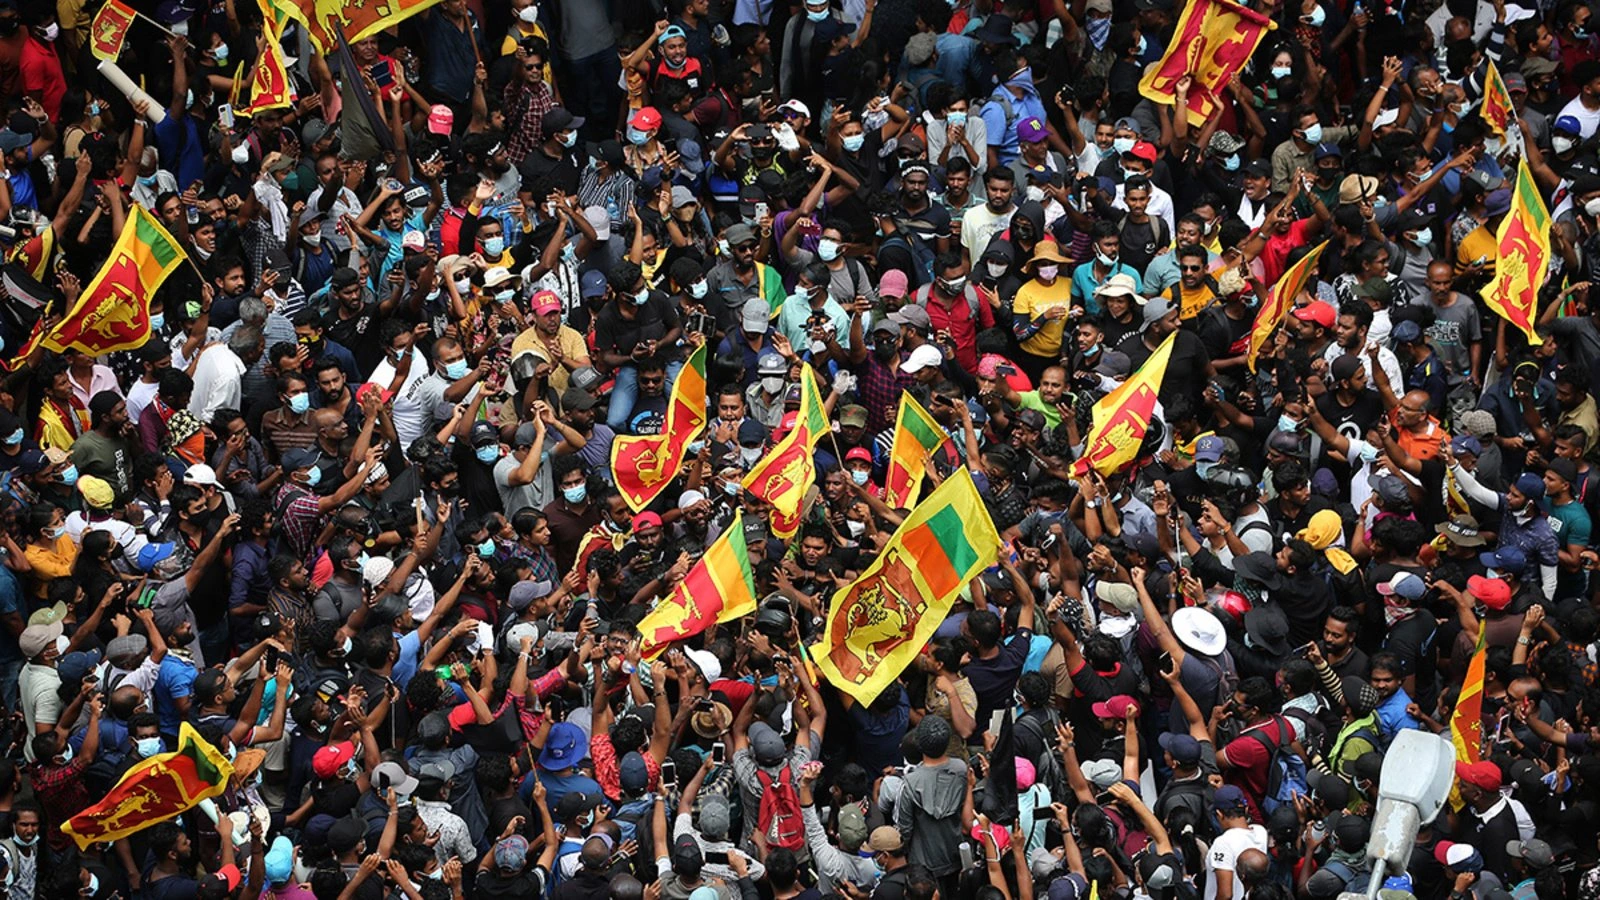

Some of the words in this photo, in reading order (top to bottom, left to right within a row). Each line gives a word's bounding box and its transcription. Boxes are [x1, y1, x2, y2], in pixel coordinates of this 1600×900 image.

[538, 294, 556, 306] FBI
[1200, 439, 1212, 449] 32
[1214, 852, 1225, 862] 32
